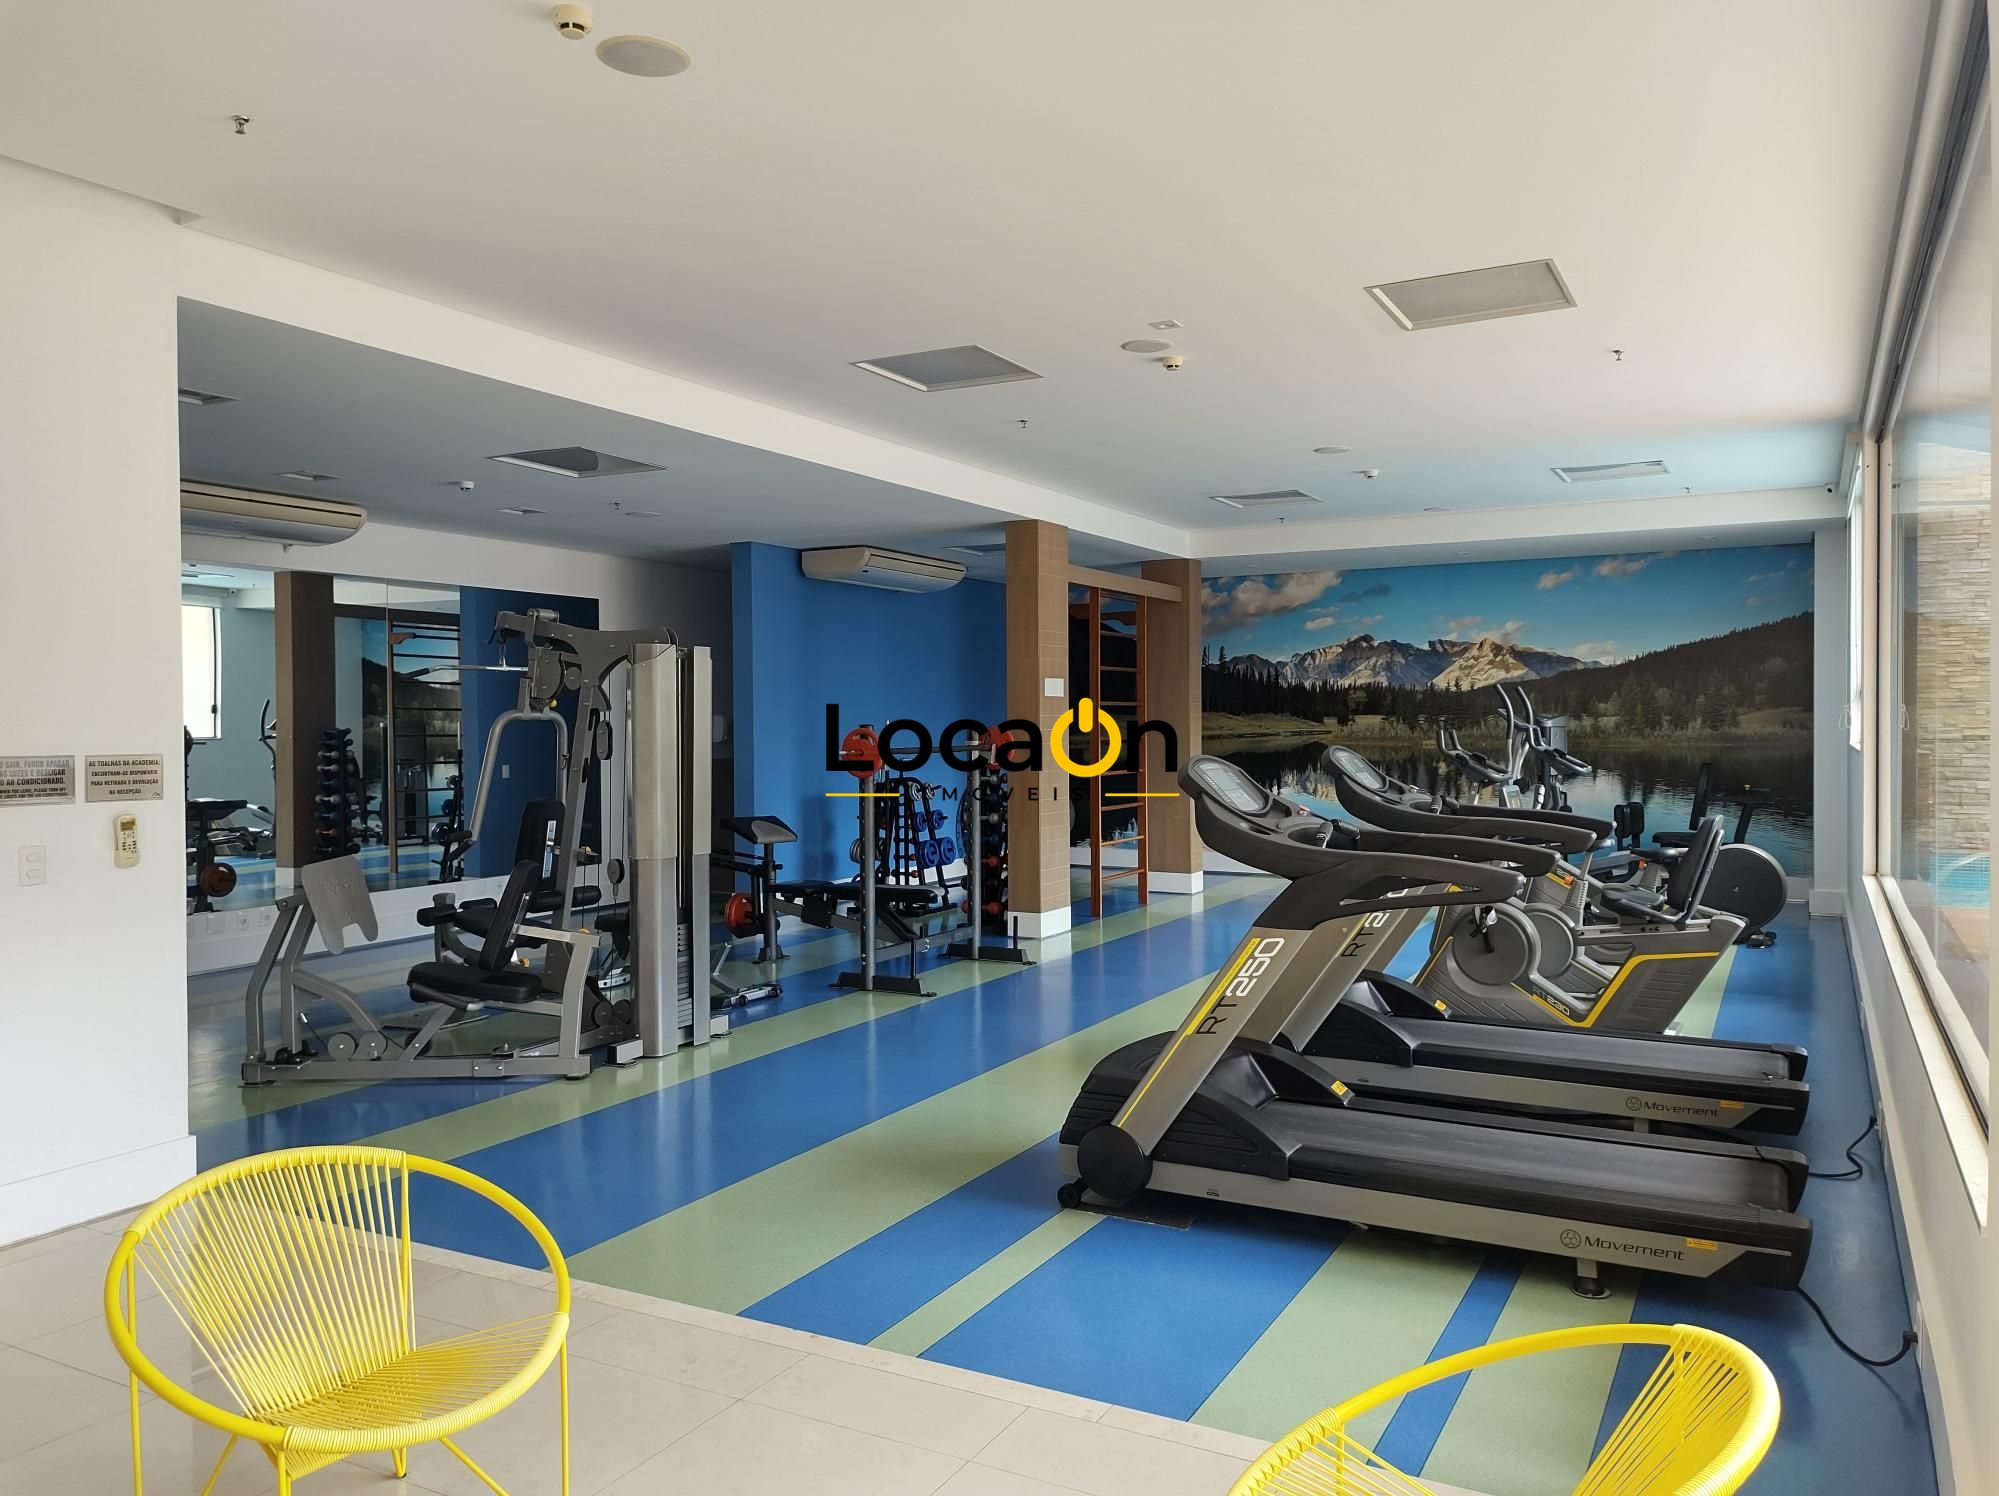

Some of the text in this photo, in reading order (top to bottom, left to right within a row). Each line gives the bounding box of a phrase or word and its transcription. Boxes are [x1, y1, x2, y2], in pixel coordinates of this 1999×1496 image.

[16, 776, 66, 786] CONDICIONADO.
[36, 768, 66, 777] DESLIGAR
[1196, 937, 1285, 1035] RT250
[1643, 1100, 1720, 1117] Movement
[1584, 1235, 1686, 1261] Movement
